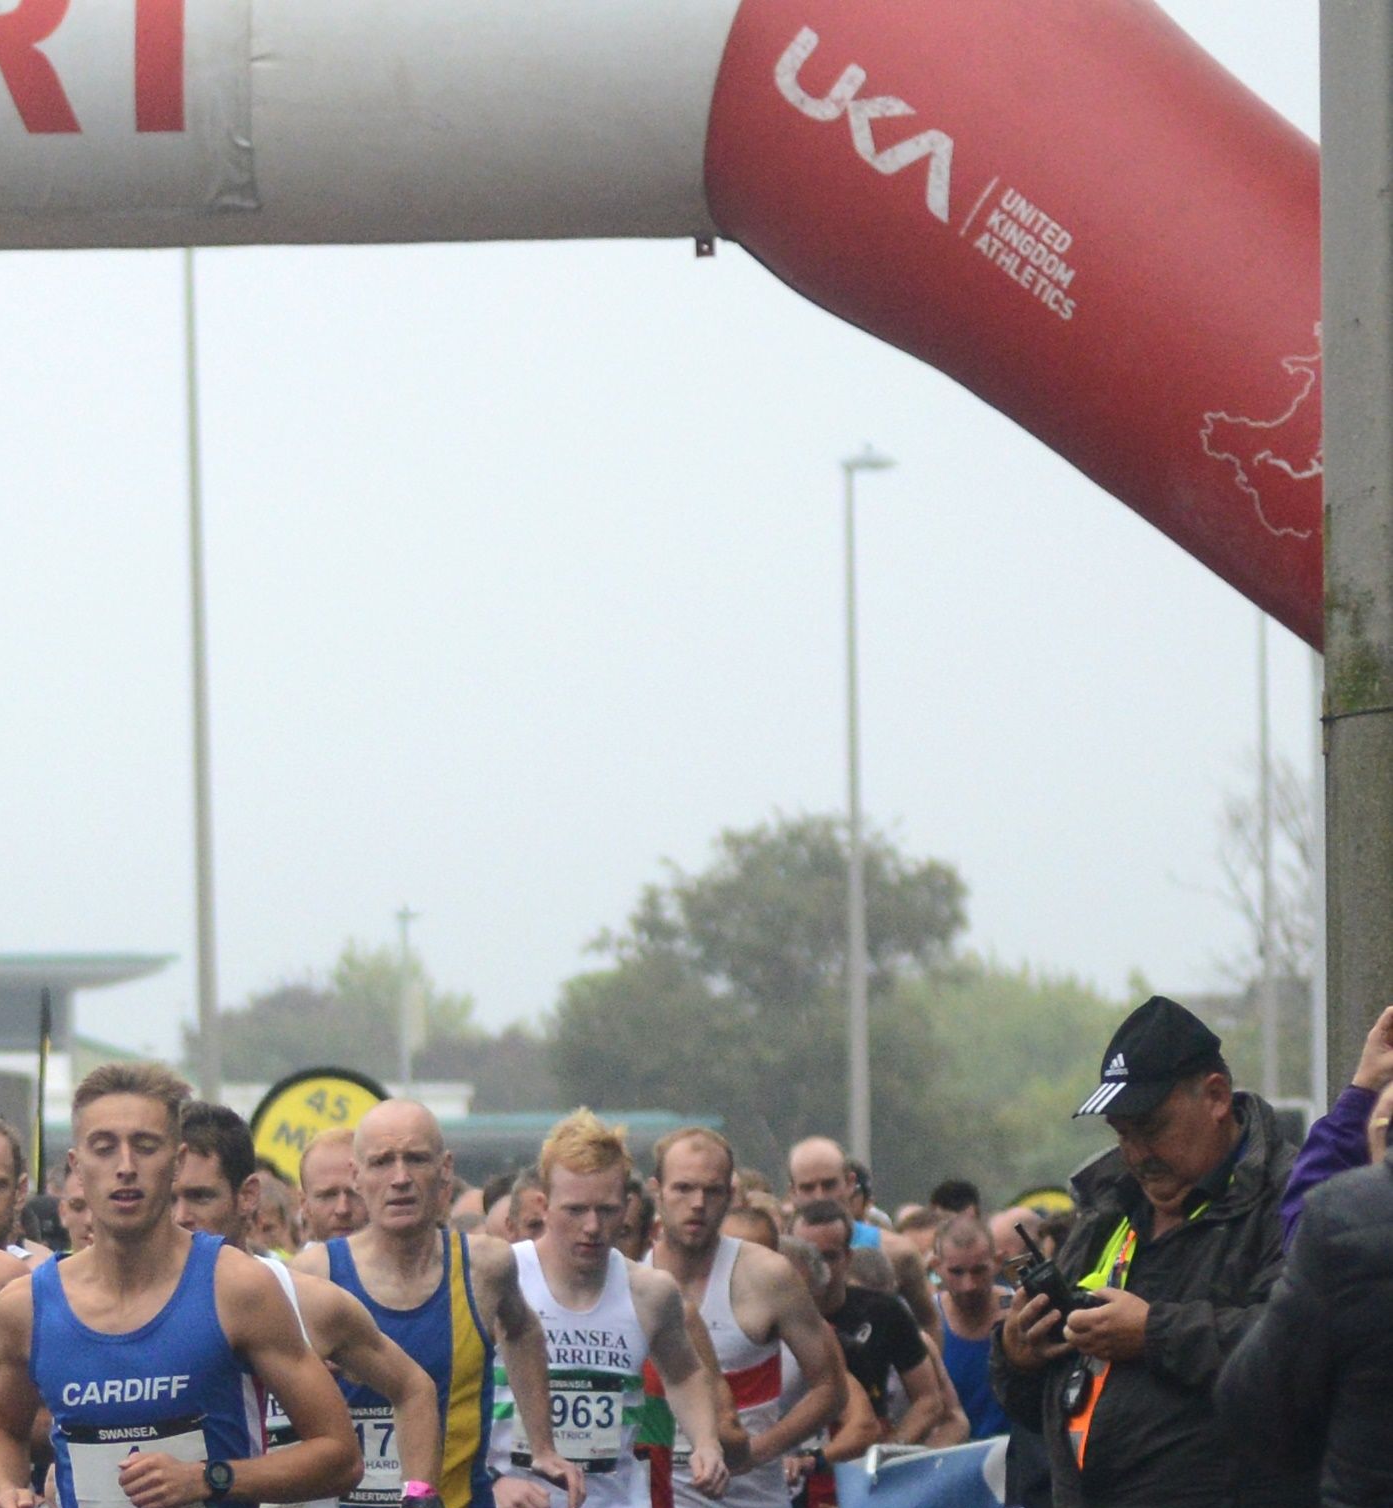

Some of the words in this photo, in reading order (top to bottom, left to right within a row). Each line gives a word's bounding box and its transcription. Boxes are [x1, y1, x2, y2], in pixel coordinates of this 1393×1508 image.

[774, 25, 954, 224] UKA
[1000, 186, 1073, 254] UNITED
[985, 207, 1076, 290] KINGDOM
[974, 231, 1077, 320] ATHLETICS
[304, 1087, 352, 1122] 45
[62, 1375, 190, 1407] CARDIFF
[98, 1425, 158, 1440] SWANSEA
[554, 1430, 592, 1440] ATRICK
